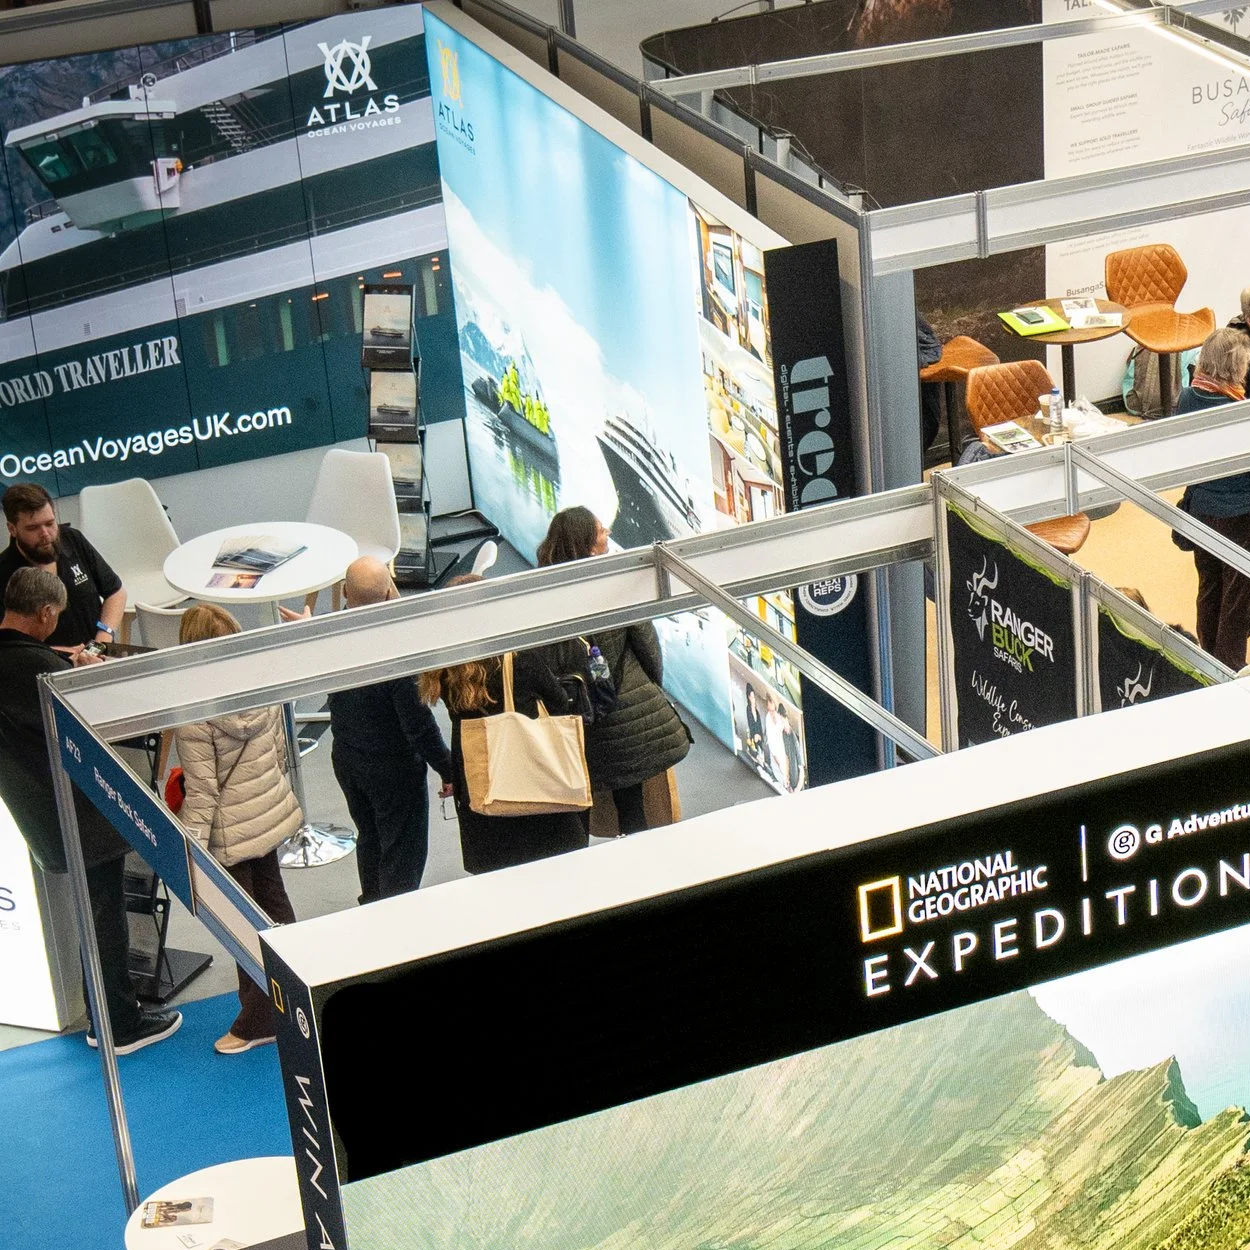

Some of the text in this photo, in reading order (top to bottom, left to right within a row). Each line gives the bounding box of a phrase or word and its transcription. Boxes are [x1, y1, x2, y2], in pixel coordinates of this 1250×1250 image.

[307, 94, 400, 126] ATLAS
[307, 117, 401, 138] OCEAN VOYAGES
[438, 103, 475, 142] ATLAS
[54, 335, 182, 393] TRAVELLER
[0, 406, 292, 477] OceanVoyagesUK.com
[814, 584, 842, 597] REPS
[991, 599, 1055, 663] RANGER
[992, 622, 1034, 673] BUCK
[993, 646, 1023, 673] SAFARIS
[971, 670, 1007, 712] Wildlife
[93, 766, 117, 801] Ranger
[117, 792, 134, 822] Buck
[134, 811, 158, 847] Safaris
[1145, 825, 1162, 844] G
[907, 850, 1019, 900] NATIONAL
[907, 865, 1049, 924] GEOGRAPHIC
[294, 1075, 329, 1200] WIN
[314, 1211, 336, 1250] A
